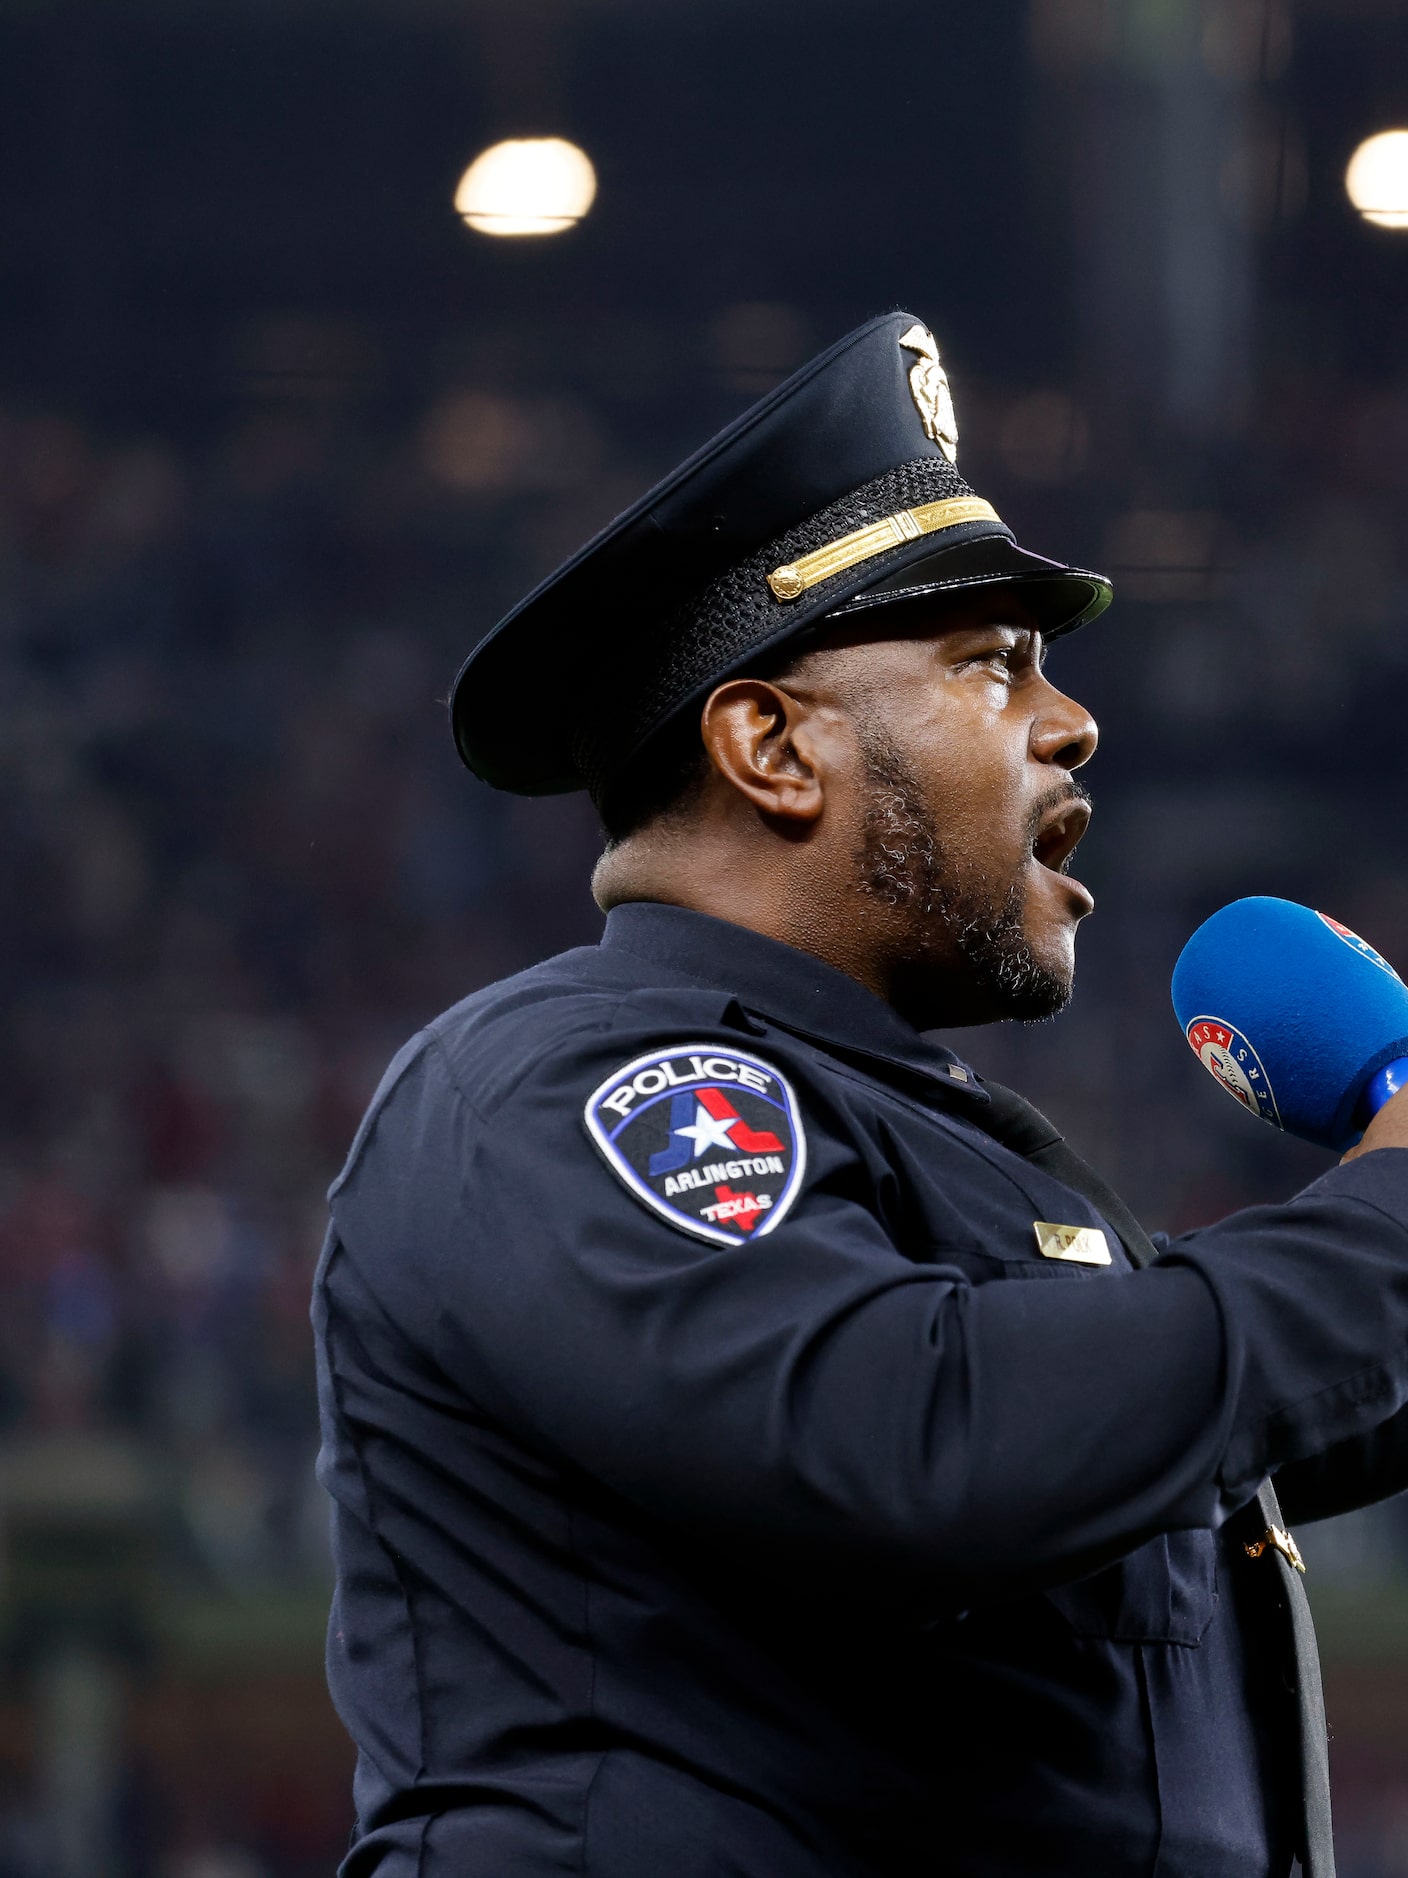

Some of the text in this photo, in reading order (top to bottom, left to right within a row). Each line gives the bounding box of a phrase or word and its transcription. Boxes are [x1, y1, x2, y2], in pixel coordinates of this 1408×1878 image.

[601, 1055, 773, 1117] POLICE
[664, 1156, 785, 1197] ARLINGTON
[700, 1194, 773, 1222] TEXAS
